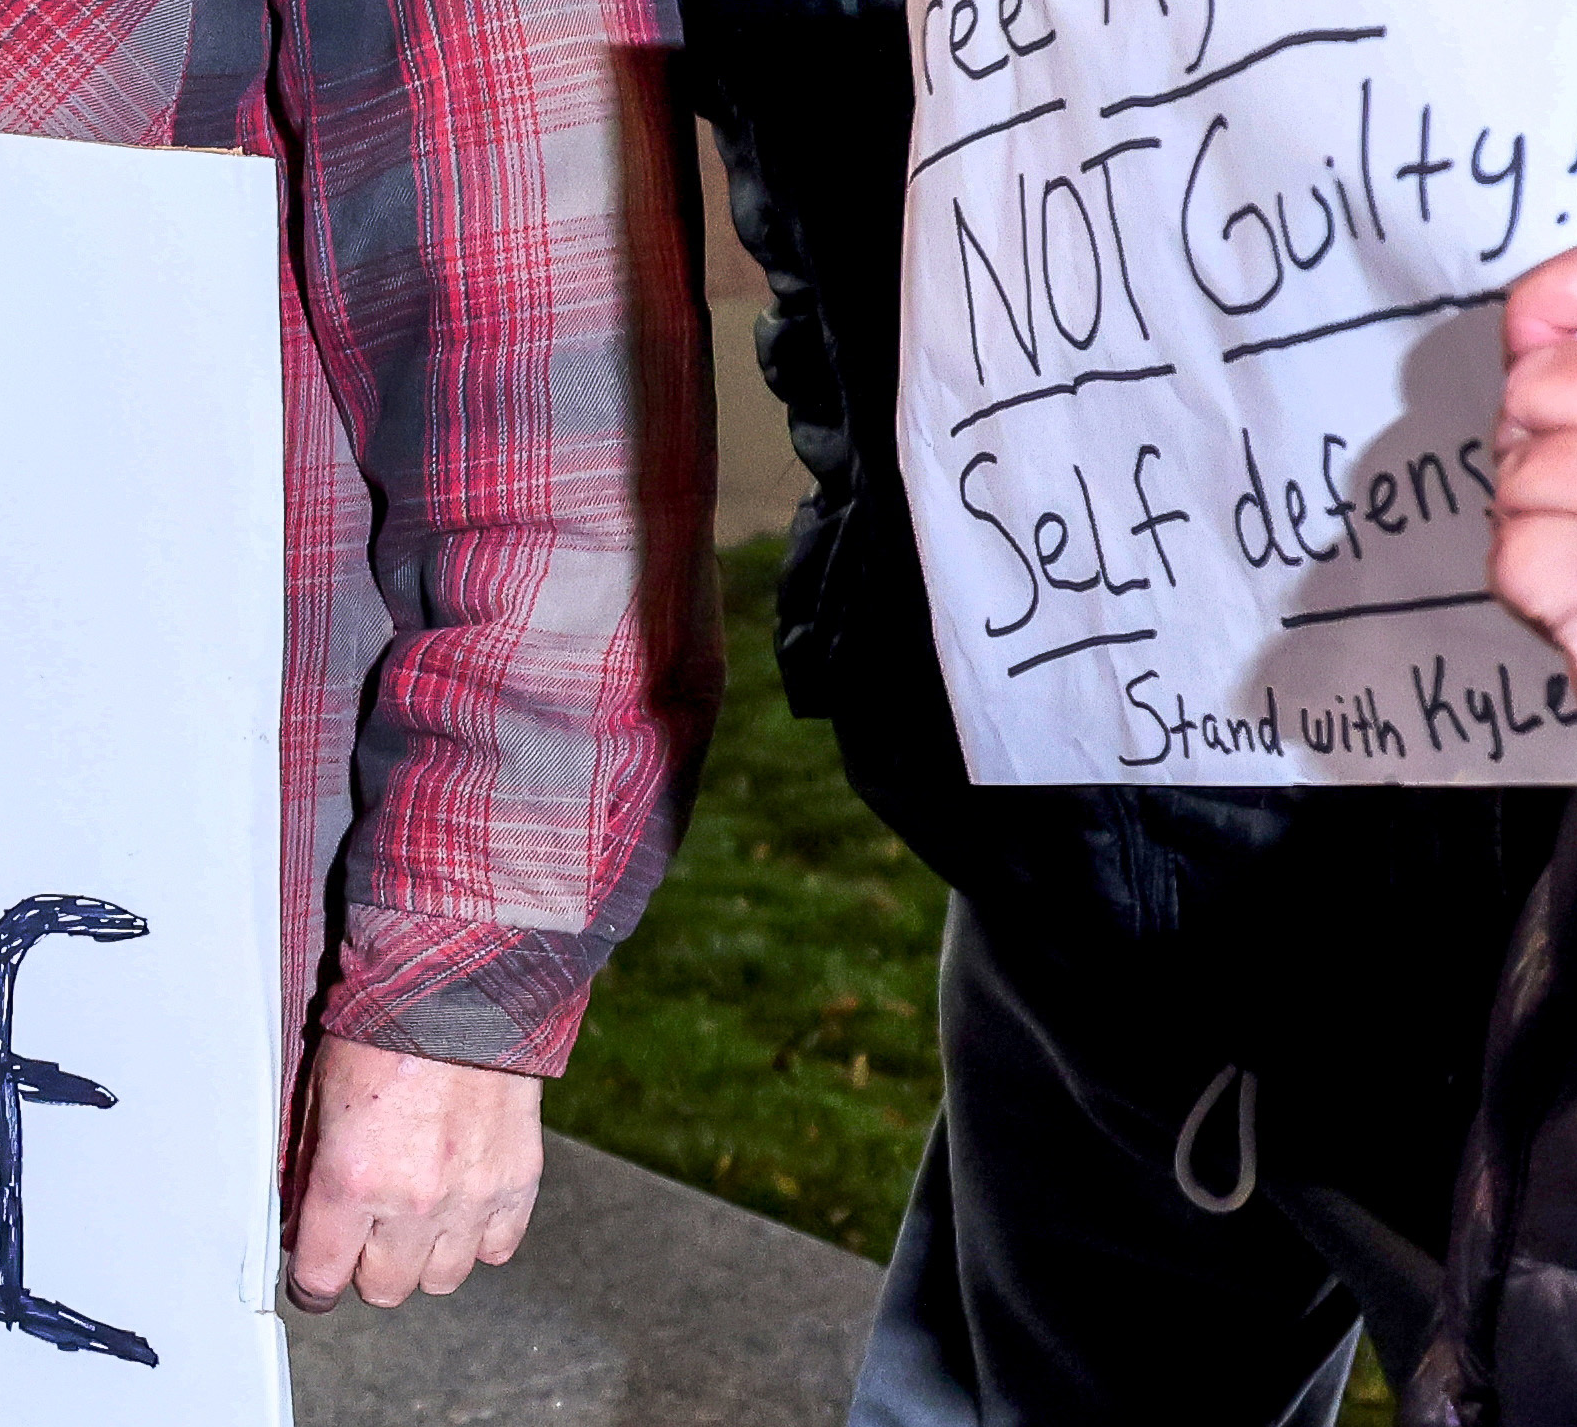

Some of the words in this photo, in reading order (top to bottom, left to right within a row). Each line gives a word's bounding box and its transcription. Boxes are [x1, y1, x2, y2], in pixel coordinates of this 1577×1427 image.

[952, 137, 1161, 385] NOT
[1235, 427, 1498, 568] defens
[1119, 670, 1284, 765] Stand
[1301, 687, 1406, 758] with
